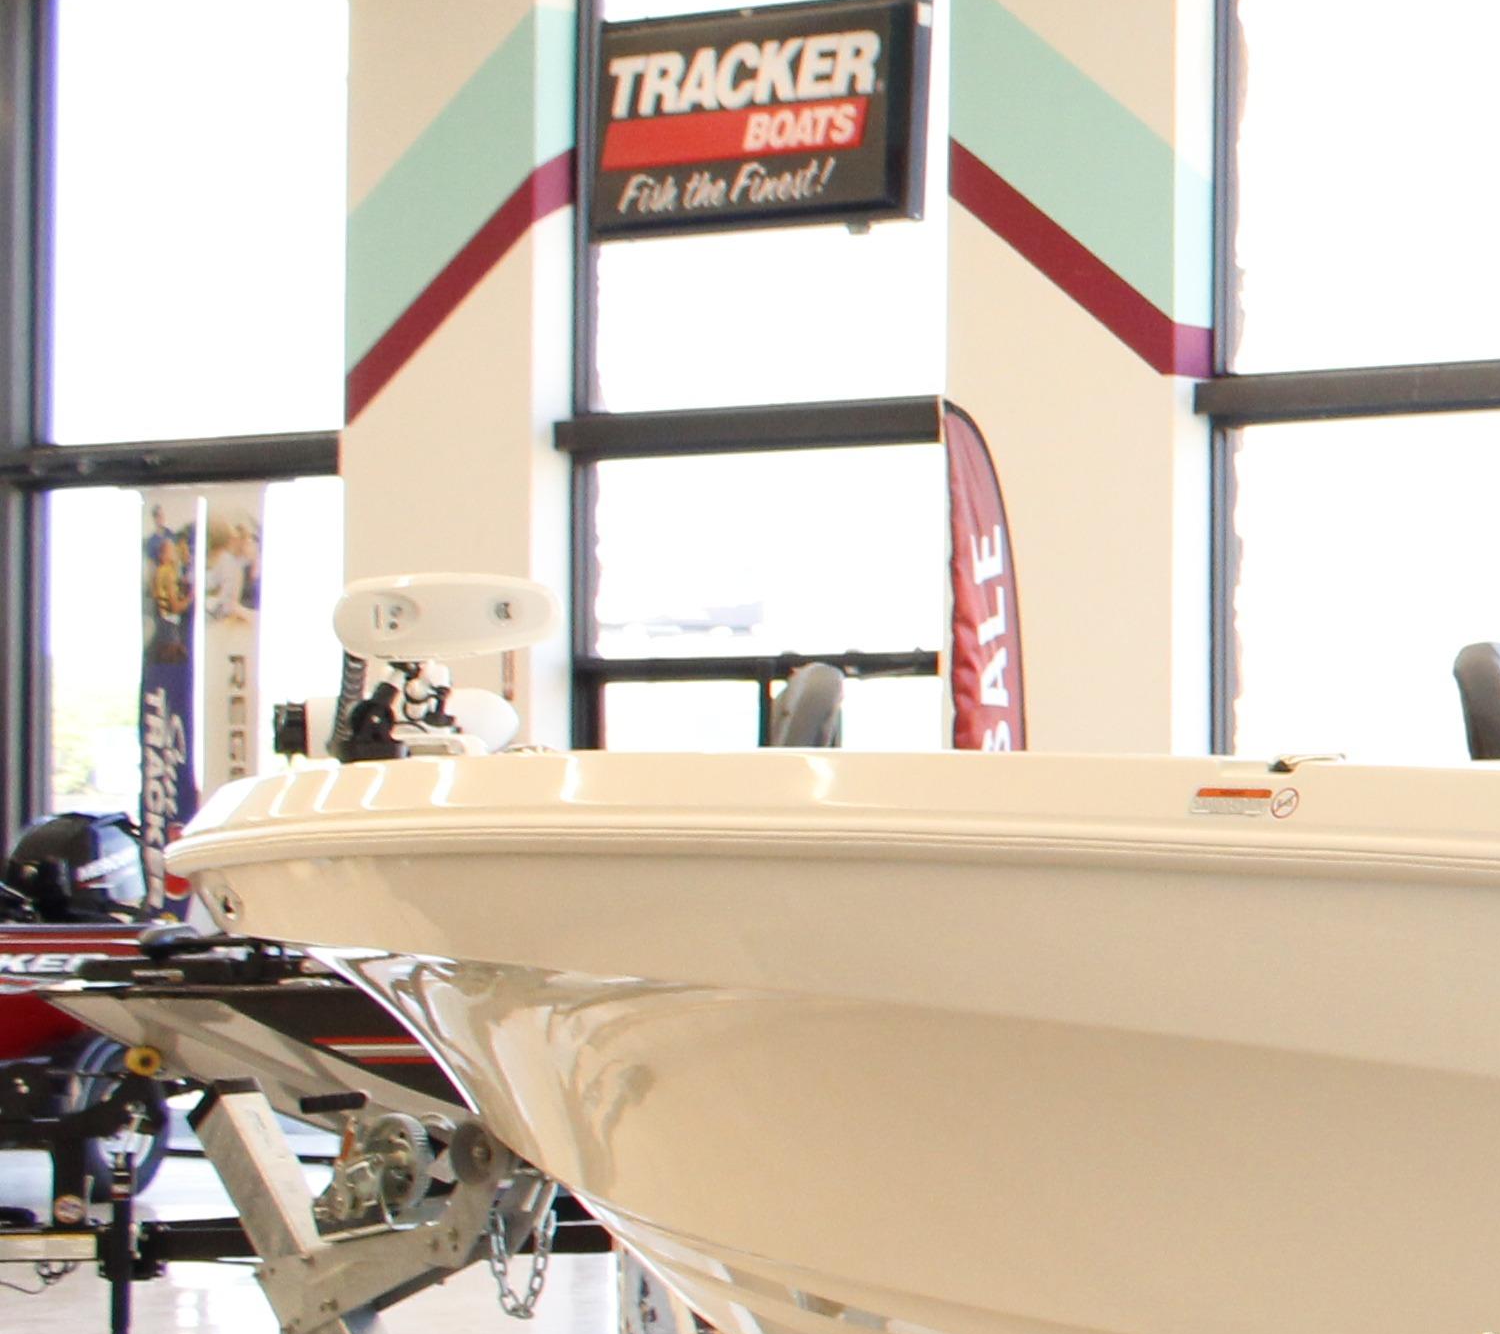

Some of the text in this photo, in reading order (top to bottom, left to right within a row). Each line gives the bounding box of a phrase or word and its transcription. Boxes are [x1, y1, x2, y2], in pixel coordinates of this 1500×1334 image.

[608, 29, 882, 118] TRACKER
[742, 102, 858, 153] BOATS
[617, 156, 836, 214] Fish the Finest!
